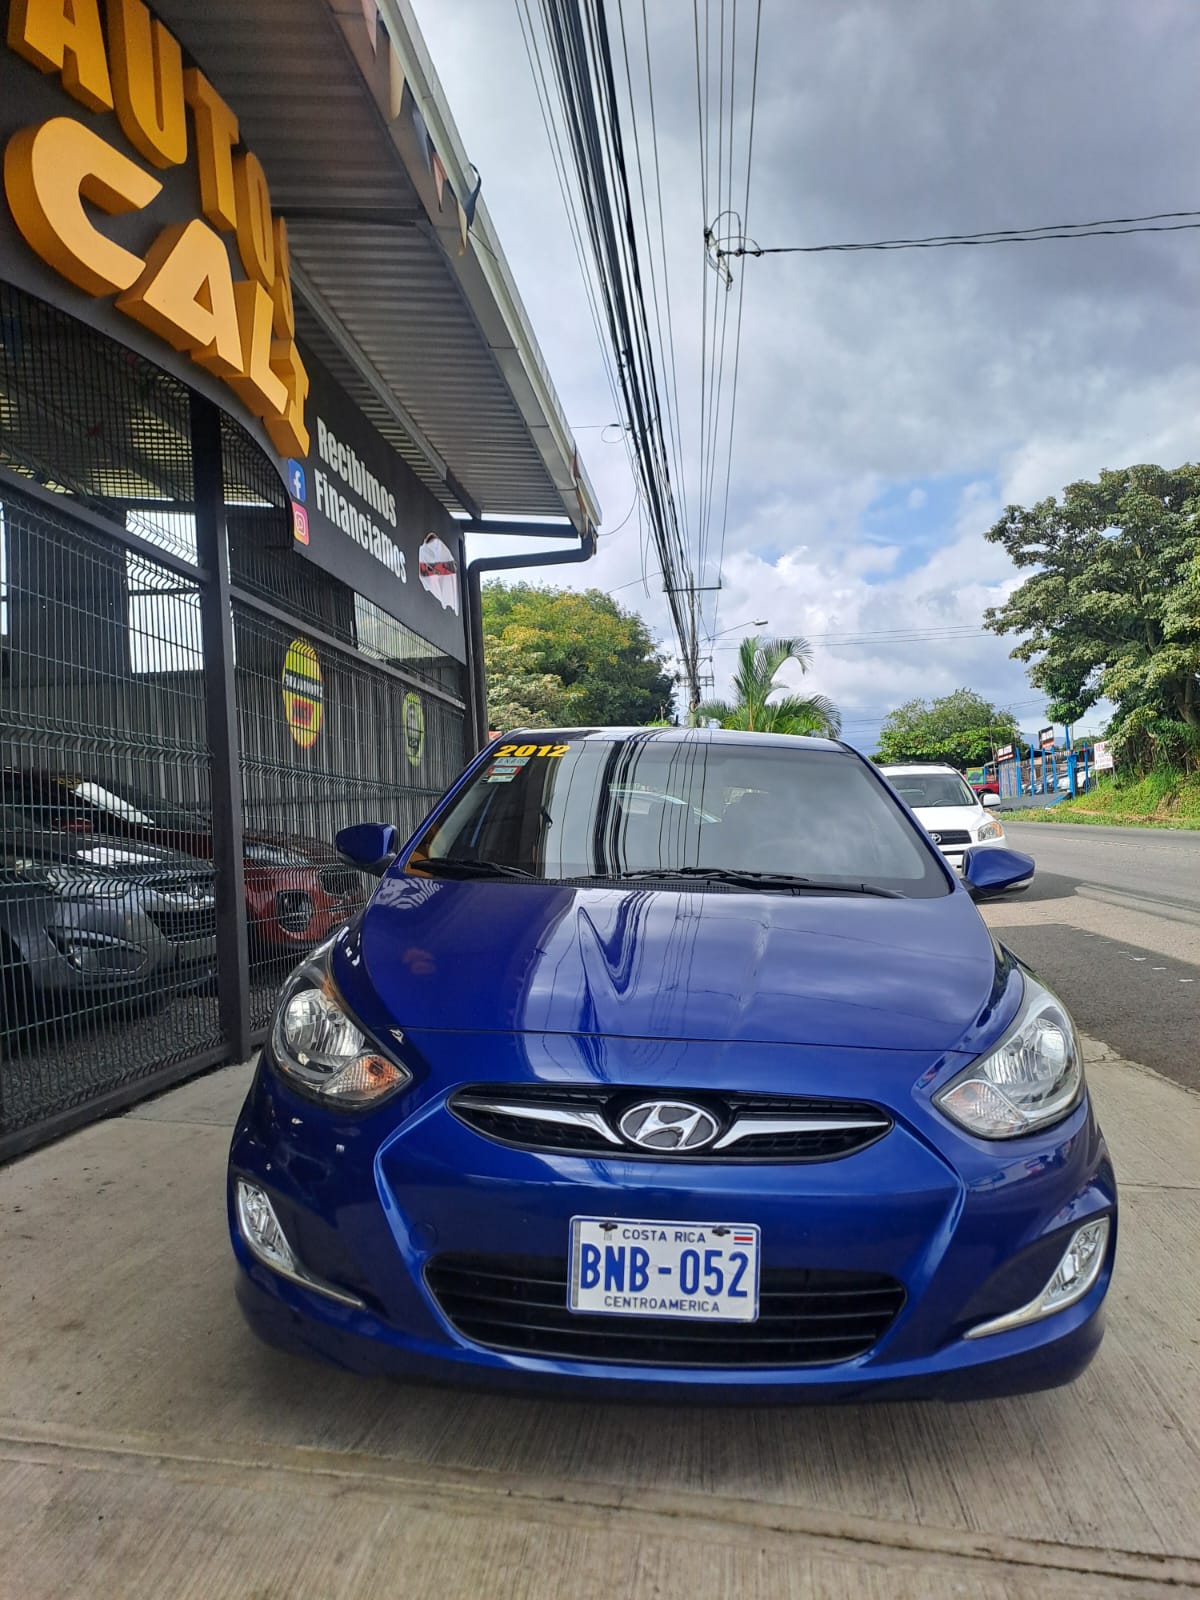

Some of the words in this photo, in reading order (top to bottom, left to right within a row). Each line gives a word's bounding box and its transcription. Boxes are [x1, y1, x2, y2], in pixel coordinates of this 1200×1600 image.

[316, 415, 397, 528] Recibimos
[314, 467, 407, 584] Financiamos
[493, 744, 571, 758] 2012
[622, 1228, 667, 1243] COSTA
[674, 1230, 706, 1244] RICA
[580, 1243, 749, 1298] BNB-052
[604, 1295, 720, 1314] CENTROAMERICA
